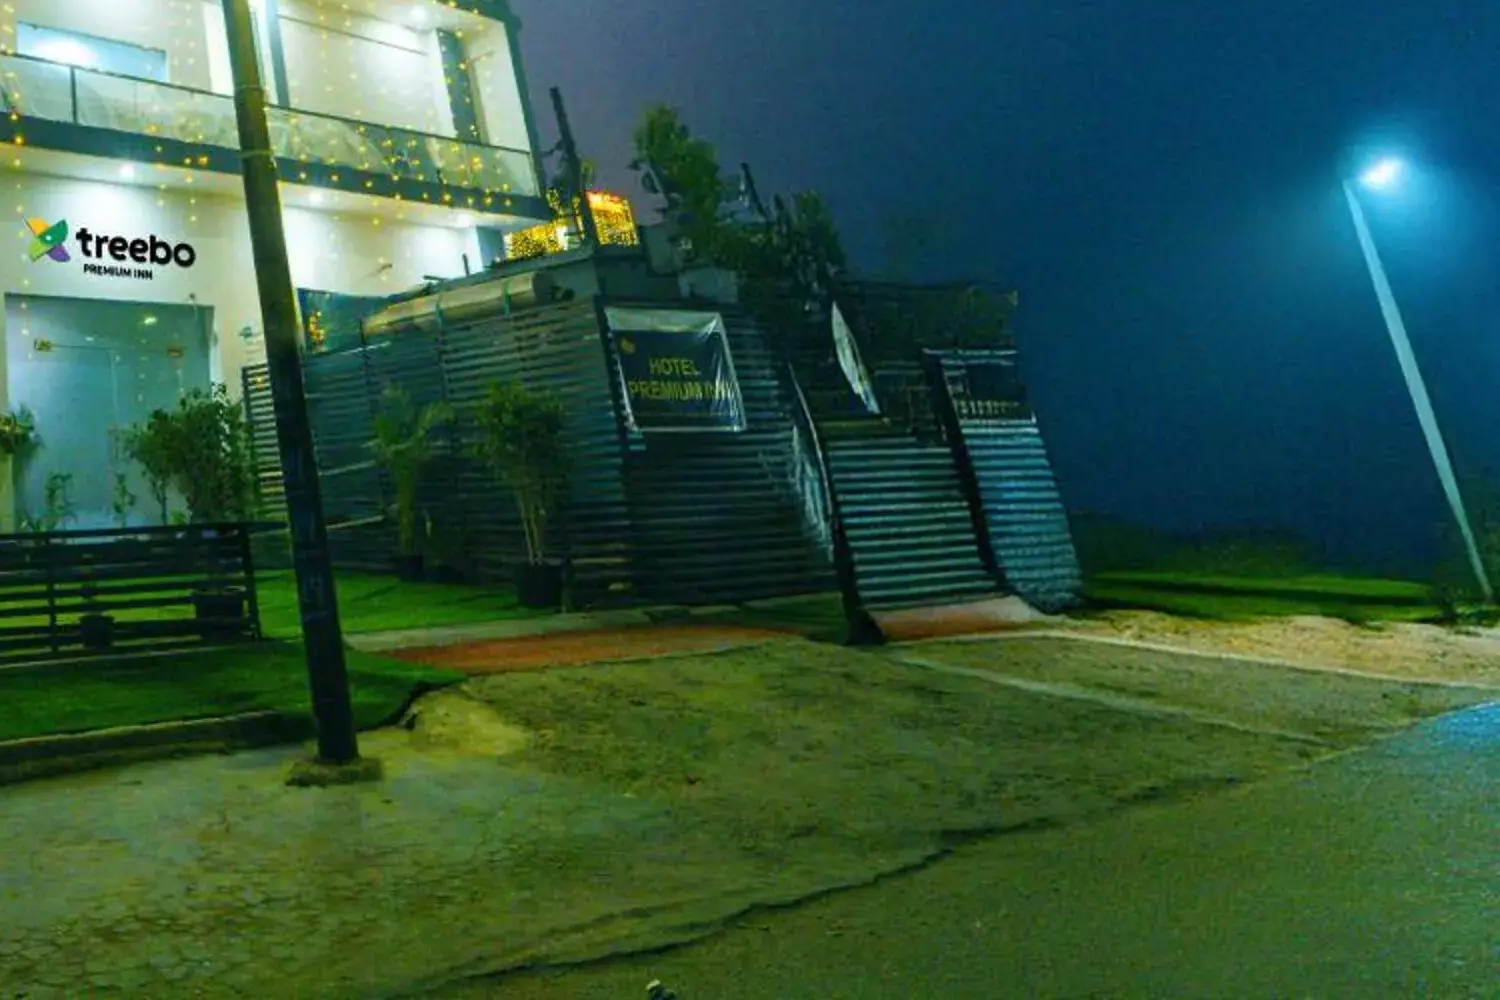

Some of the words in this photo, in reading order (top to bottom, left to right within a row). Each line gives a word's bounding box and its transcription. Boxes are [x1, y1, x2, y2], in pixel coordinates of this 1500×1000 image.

[76, 227, 196, 268] treebo
[84, 263, 132, 278] PREMIUM
[134, 268, 153, 280] INN
[649, 358, 701, 376] HOTEL
[627, 380, 703, 401] PREMIUM
